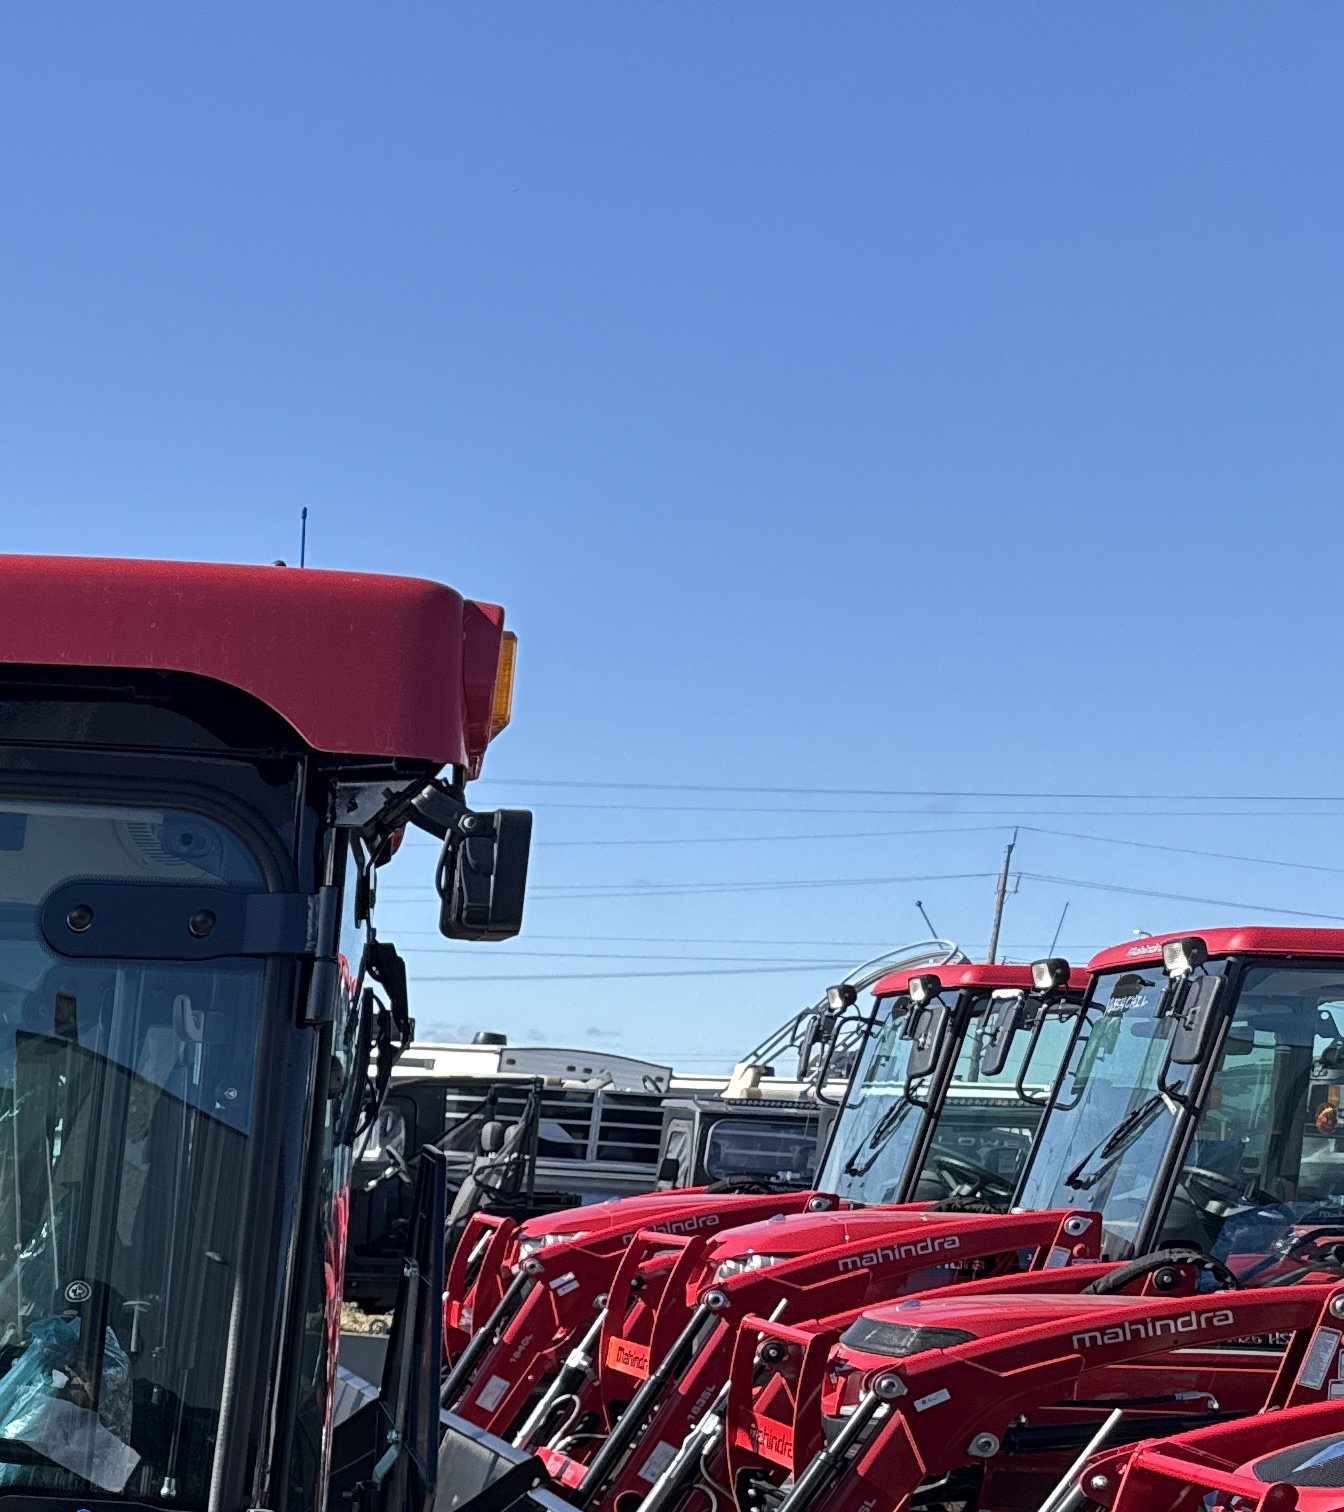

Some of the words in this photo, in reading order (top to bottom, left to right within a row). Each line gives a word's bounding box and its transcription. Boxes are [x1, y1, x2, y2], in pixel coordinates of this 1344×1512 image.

[623, 1214, 719, 1244] mhindra
[838, 1236, 960, 1272] mahindra
[1072, 1308, 1234, 1349] mahindra
